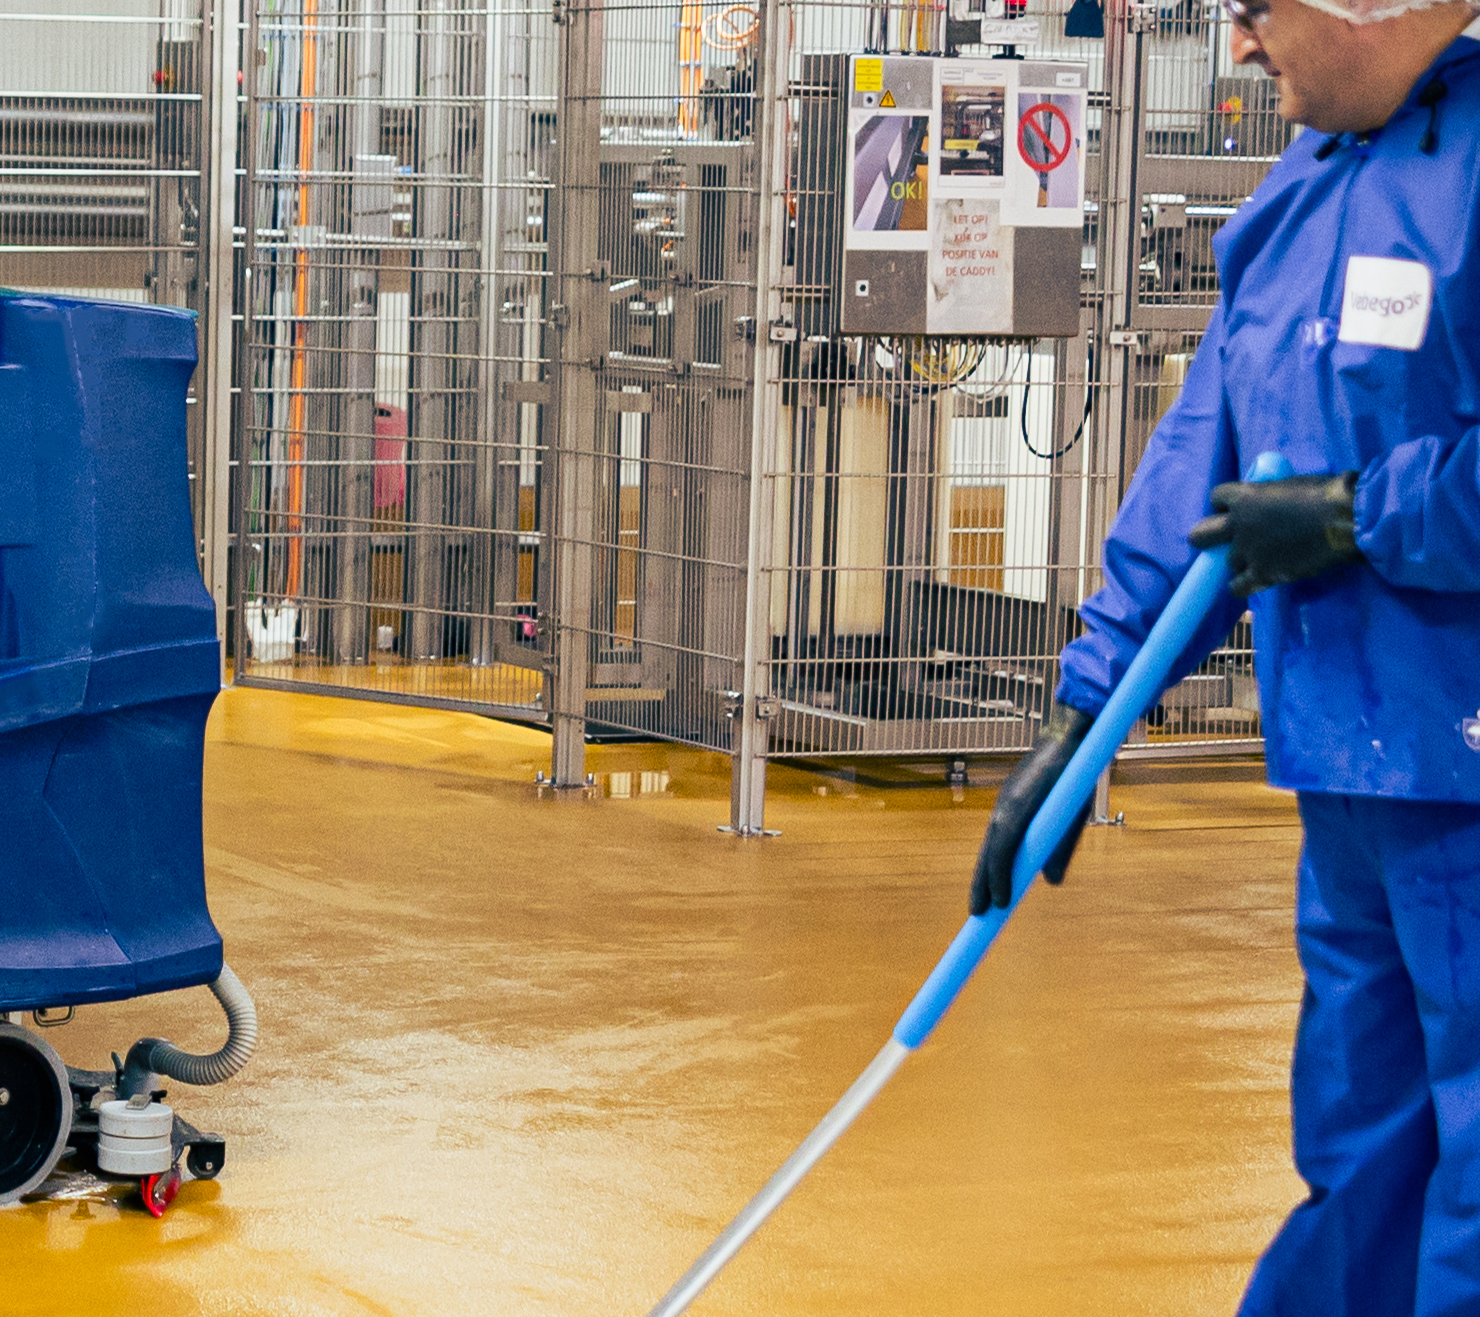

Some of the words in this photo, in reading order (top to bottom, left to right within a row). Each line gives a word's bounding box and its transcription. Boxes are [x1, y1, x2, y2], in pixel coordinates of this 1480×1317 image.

[891, 181, 923, 201] OK!
[953, 214, 969, 225] LET
[974, 232, 988, 243] OP
[978, 249, 1000, 260] VAN
[946, 266, 958, 277] DE
[960, 266, 995, 277] CADDY!
